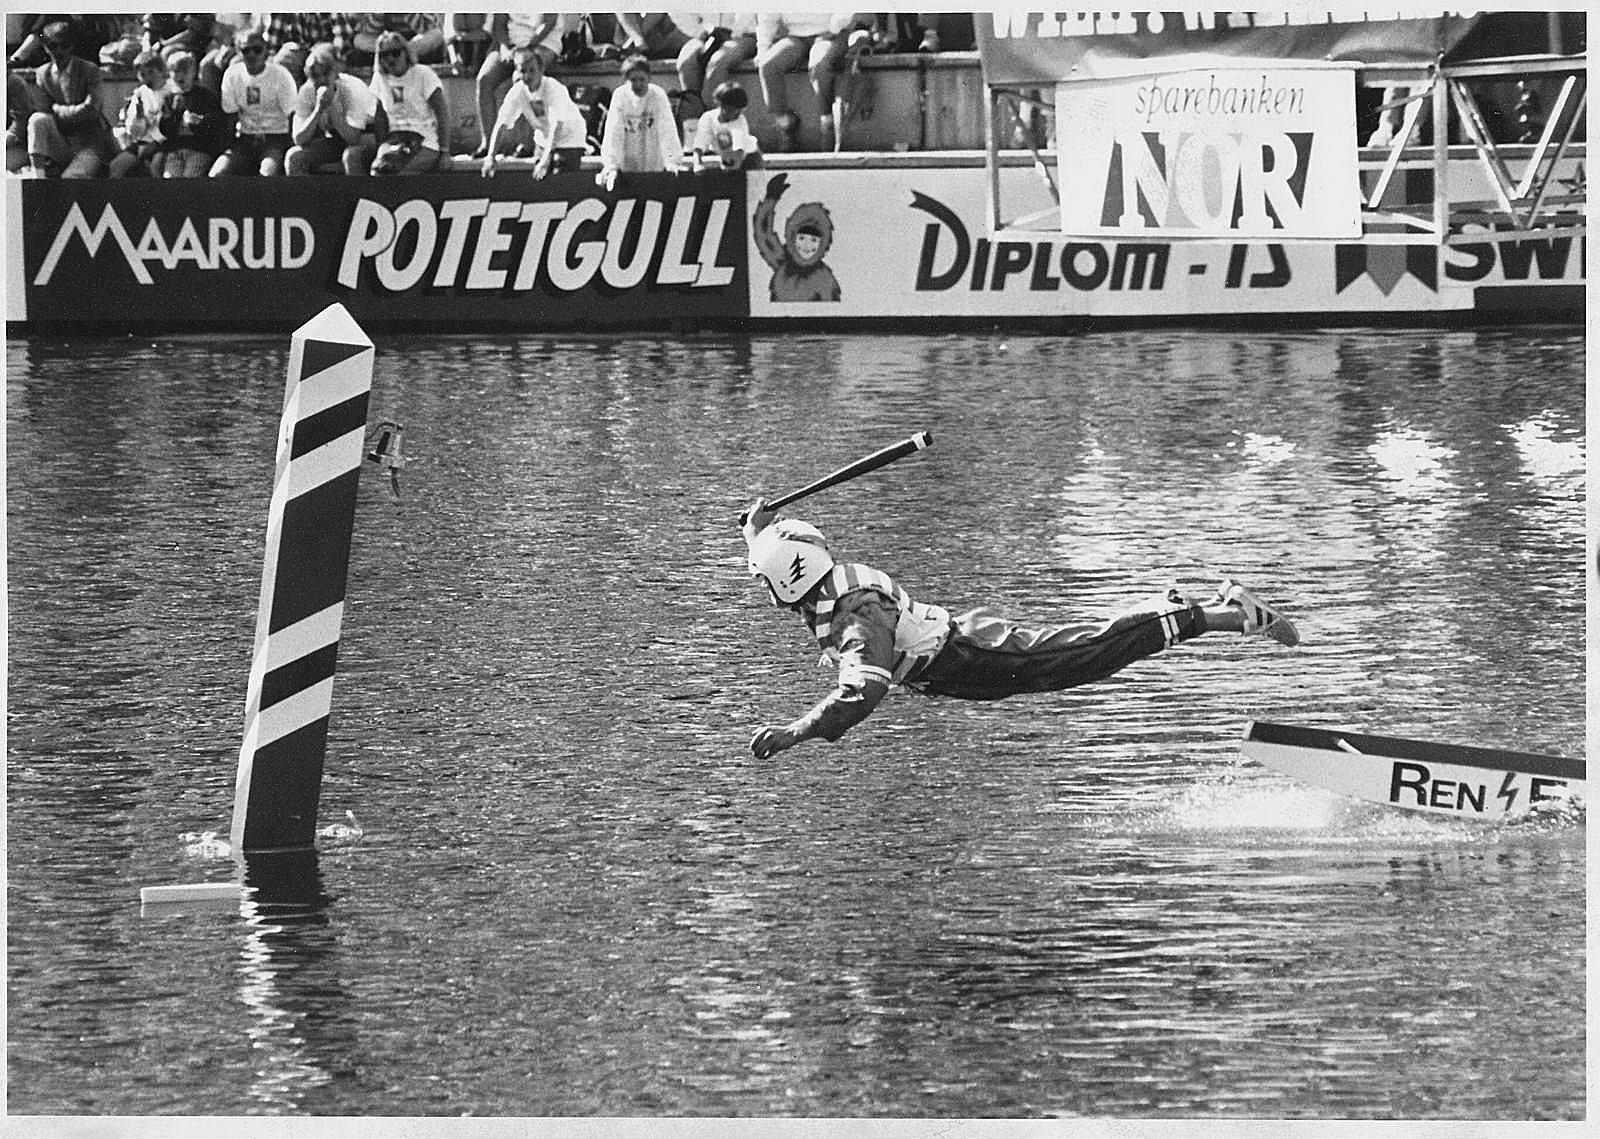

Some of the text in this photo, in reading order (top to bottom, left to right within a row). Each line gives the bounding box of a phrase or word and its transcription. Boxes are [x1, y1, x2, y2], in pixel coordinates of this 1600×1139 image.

[1135, 75, 1304, 123] sparebanken
[1099, 131, 1314, 229] NOR
[33, 196, 735, 291] MAARUD POTETGULL
[1444, 223, 1587, 282] SW
